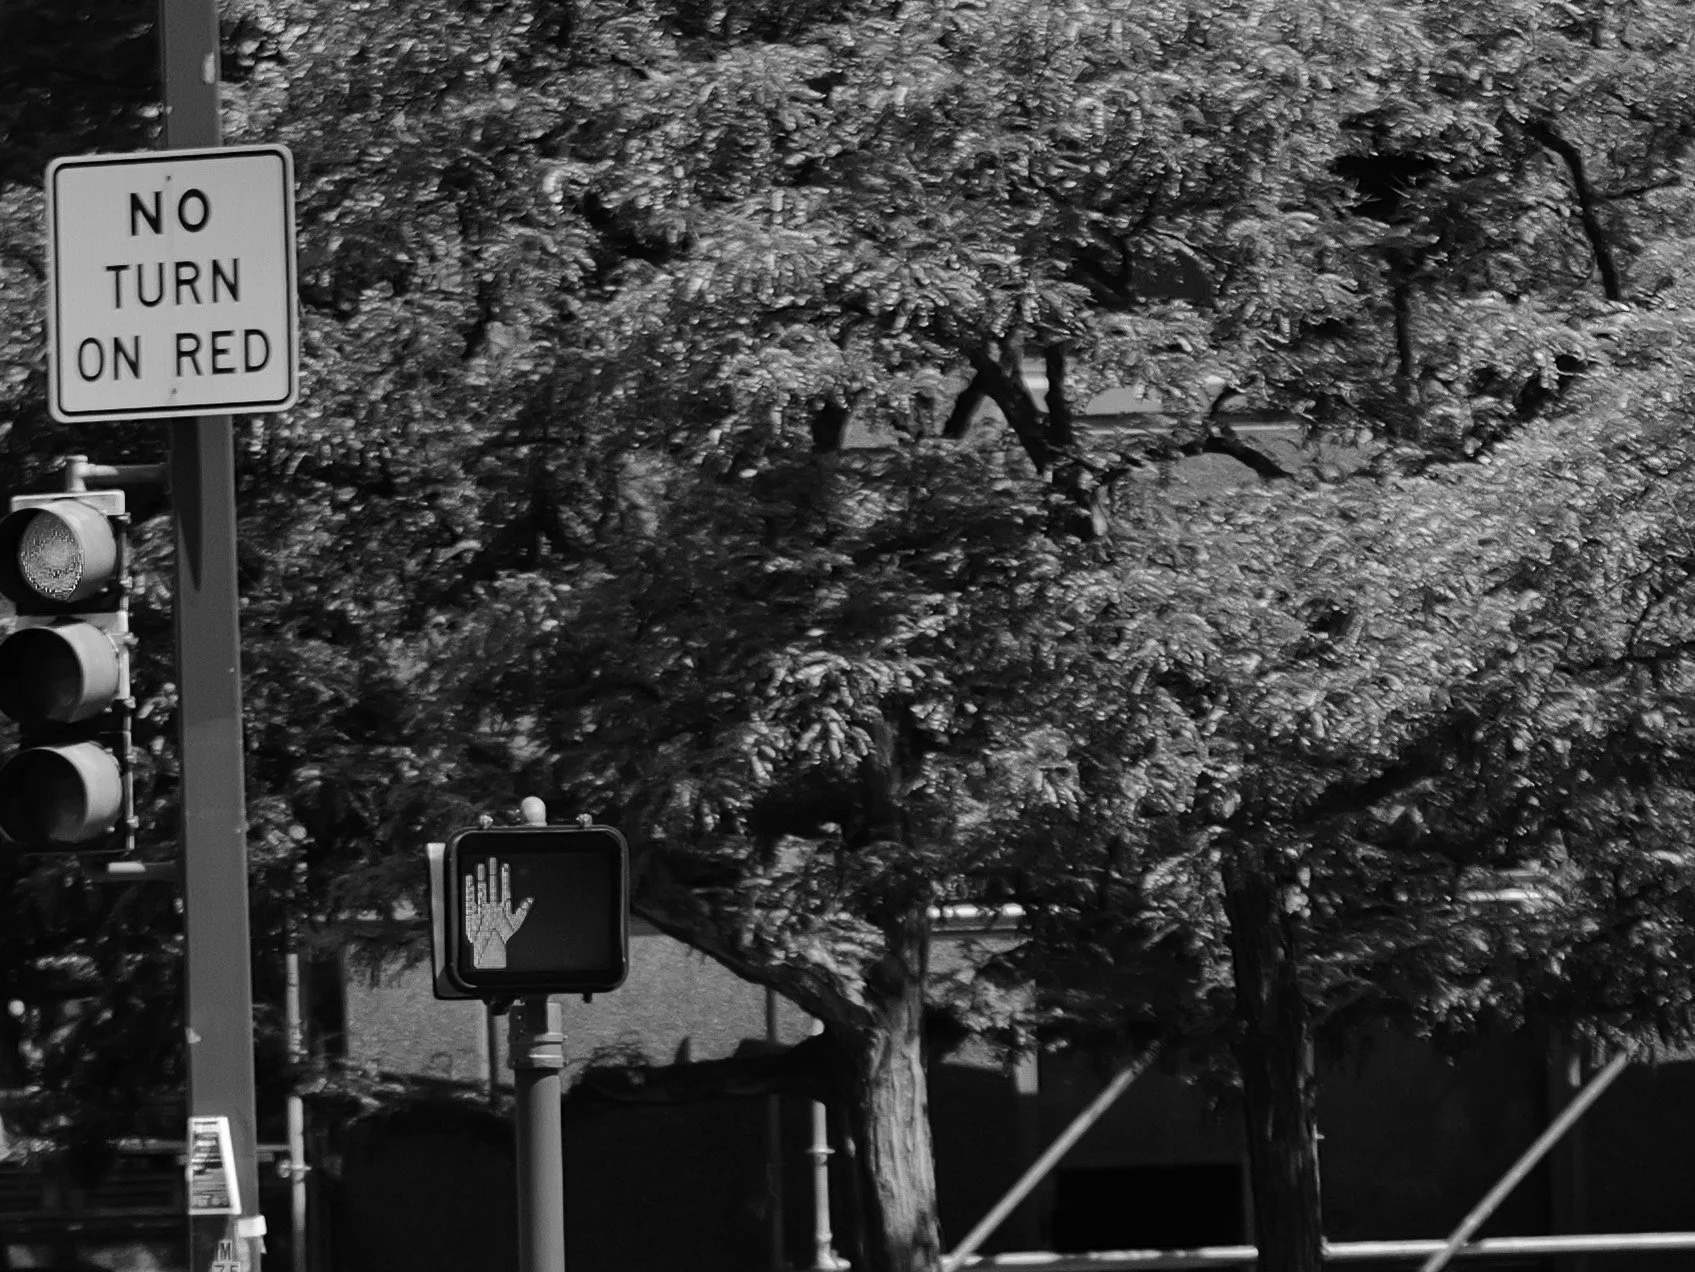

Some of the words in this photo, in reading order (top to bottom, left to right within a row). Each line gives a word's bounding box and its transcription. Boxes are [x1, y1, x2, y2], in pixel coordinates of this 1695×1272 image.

[130, 188, 211, 236] NO
[106, 258, 240, 309] TURN
[77, 335, 142, 382] ON
[175, 328, 271, 377] RED
